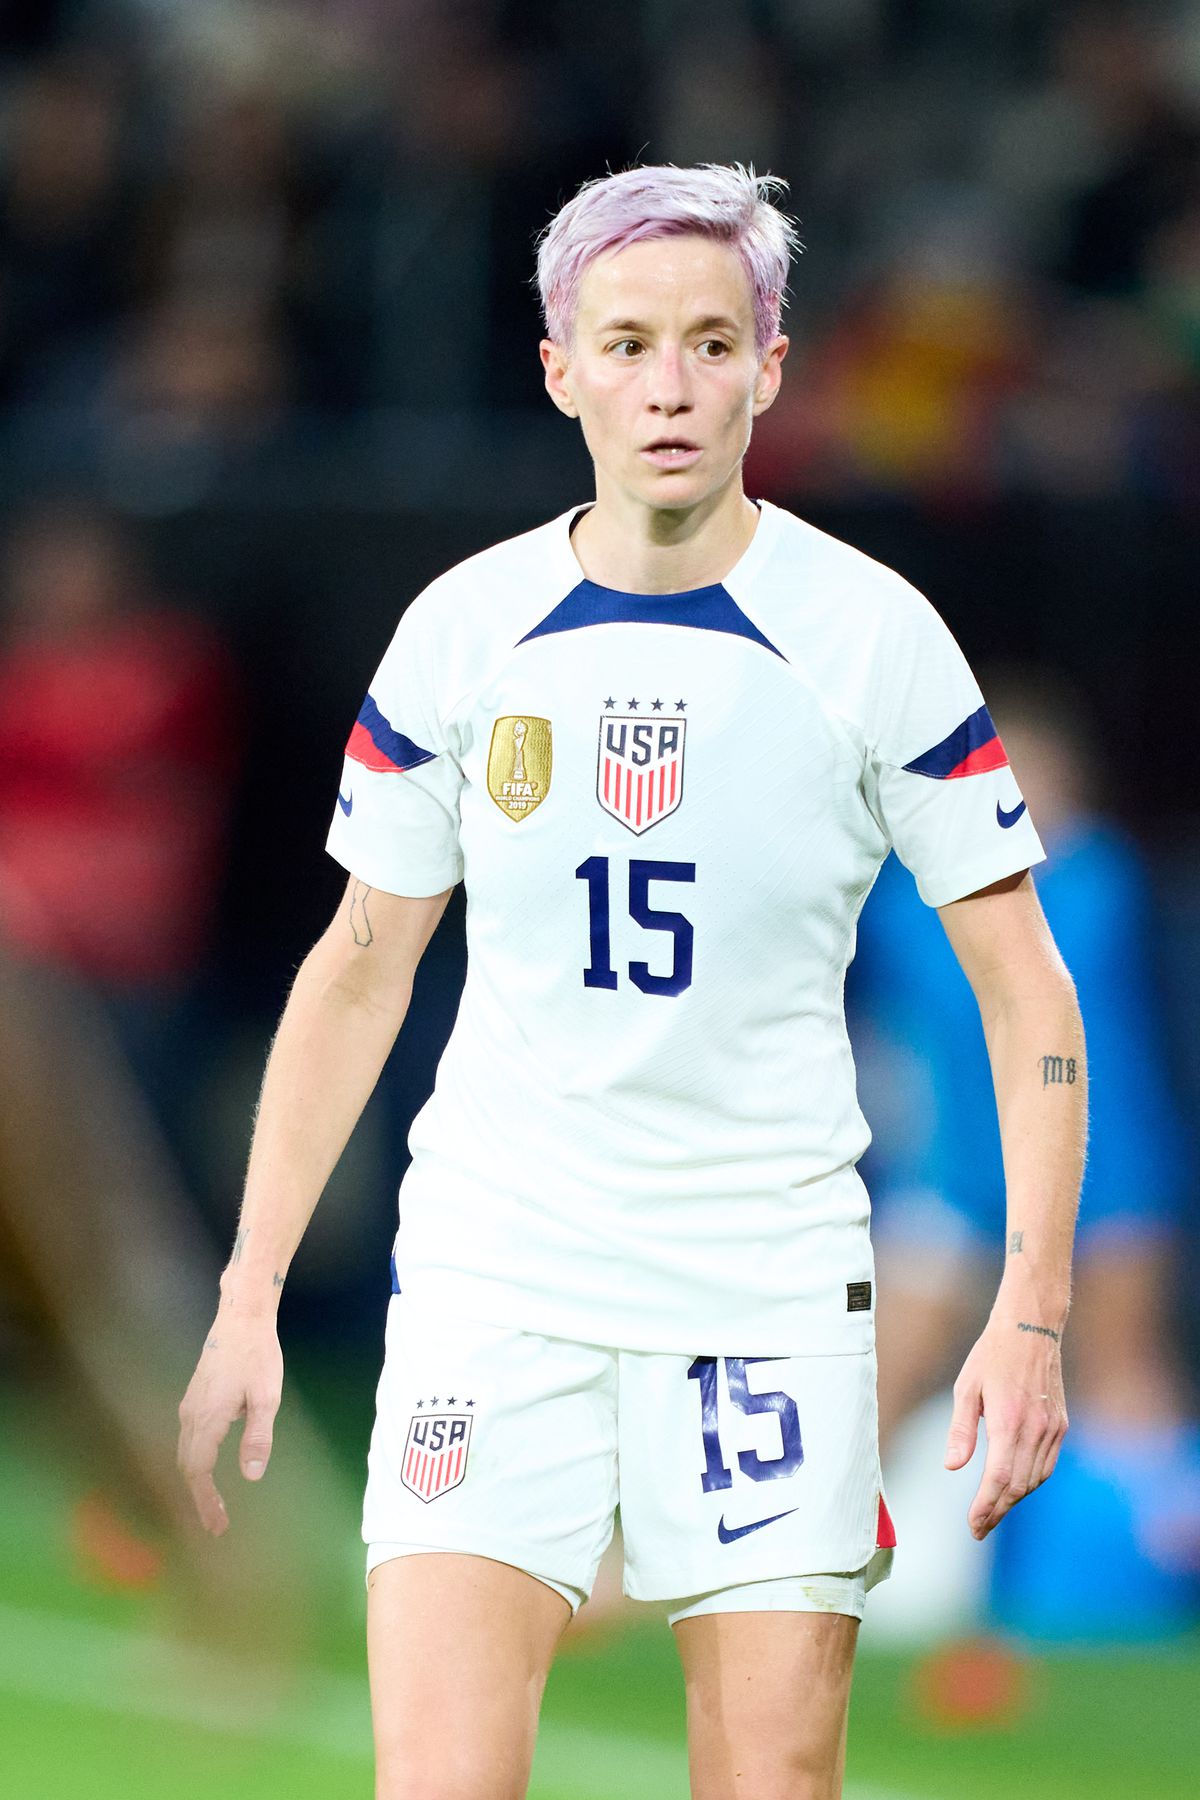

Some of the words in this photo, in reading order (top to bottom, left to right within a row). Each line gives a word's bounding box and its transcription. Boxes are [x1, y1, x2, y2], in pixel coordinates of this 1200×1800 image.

[606, 723, 679, 767] USA
[502, 782, 533, 796] FIFA
[508, 801, 527, 810] 2019
[575, 856, 696, 998] 15
[413, 1420, 467, 1452] USA
[687, 1355, 804, 1493] 15
